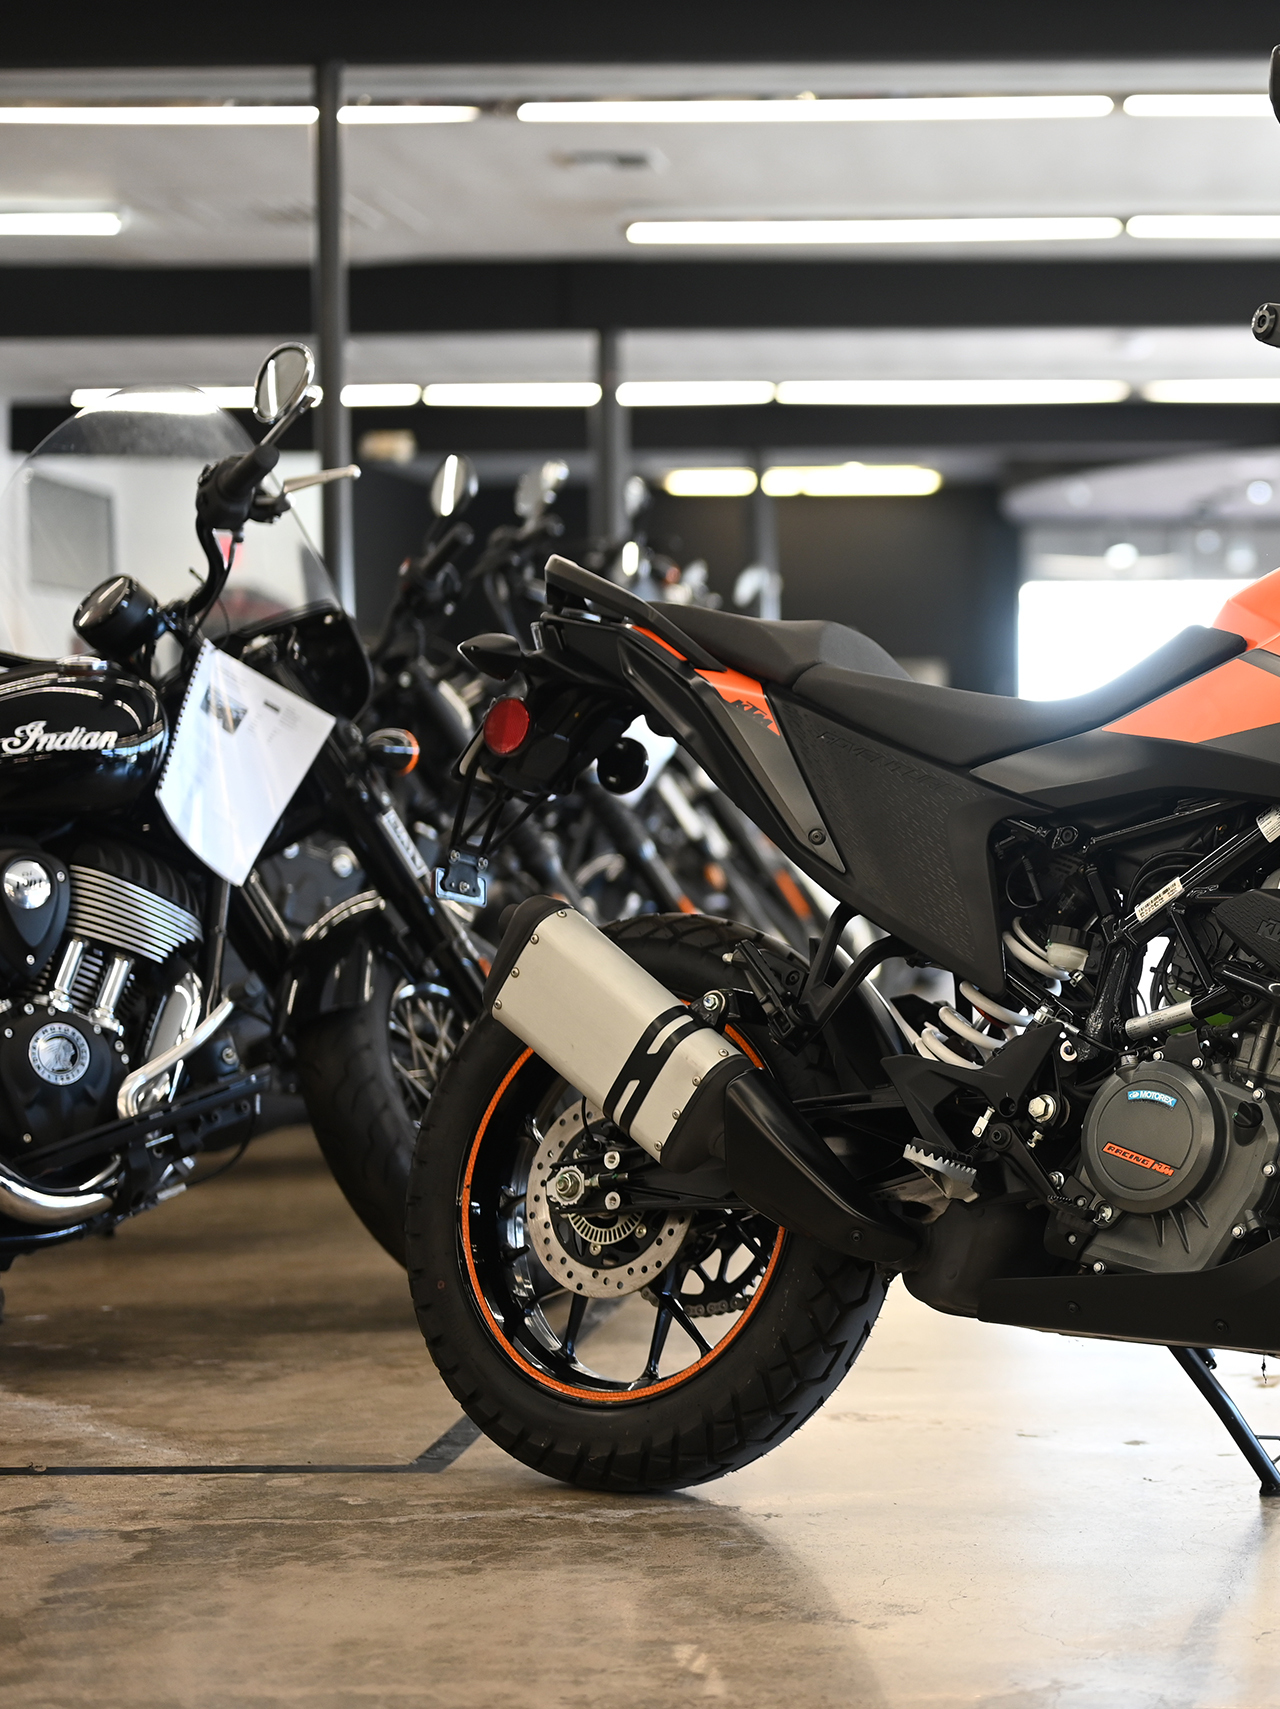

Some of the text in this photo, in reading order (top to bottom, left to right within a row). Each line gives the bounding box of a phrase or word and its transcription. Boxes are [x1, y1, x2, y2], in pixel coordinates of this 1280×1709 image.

[1, 720, 118, 754] Indian
[1140, 1090, 1174, 1106] MOTOREX
[1107, 1145, 1174, 1177] RACING KTM
